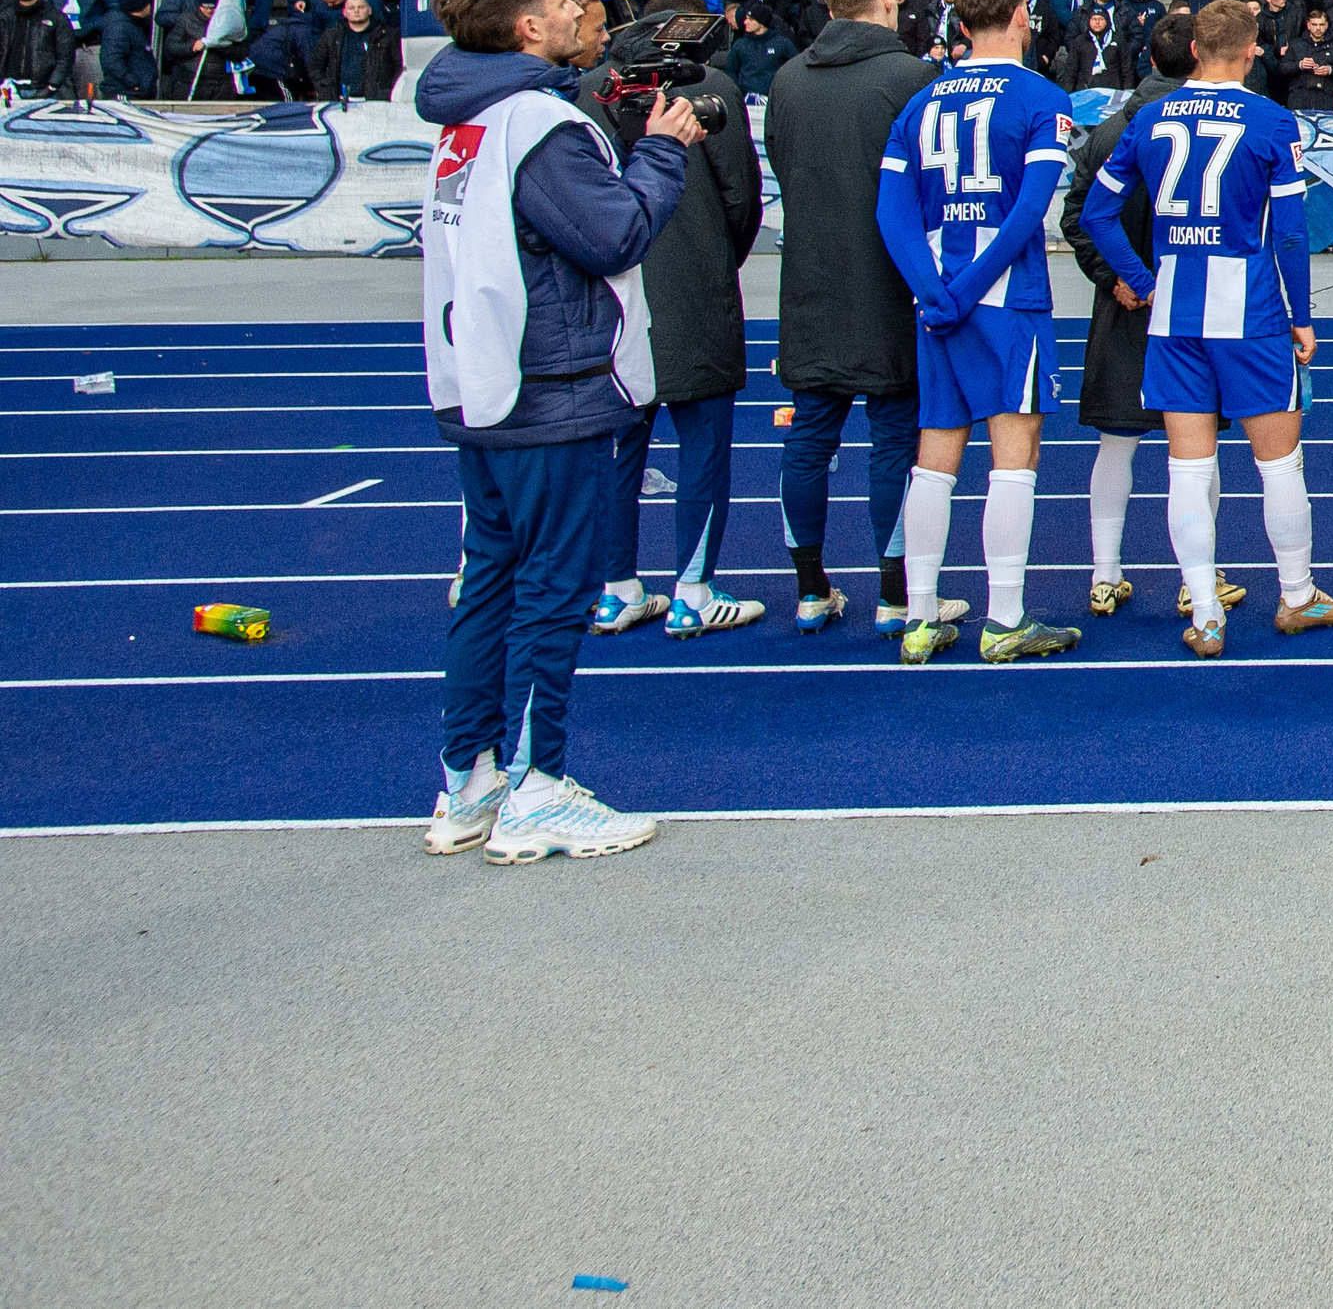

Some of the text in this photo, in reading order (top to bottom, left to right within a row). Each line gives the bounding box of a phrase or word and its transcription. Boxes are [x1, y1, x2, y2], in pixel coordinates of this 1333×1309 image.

[931, 77, 1010, 98] HERTHA BSC
[1161, 99, 1246, 119] HERTHA BSC
[919, 97, 1002, 195] 41
[1151, 119, 1246, 217] 27
[1168, 225, 1222, 245] CUSANCE
